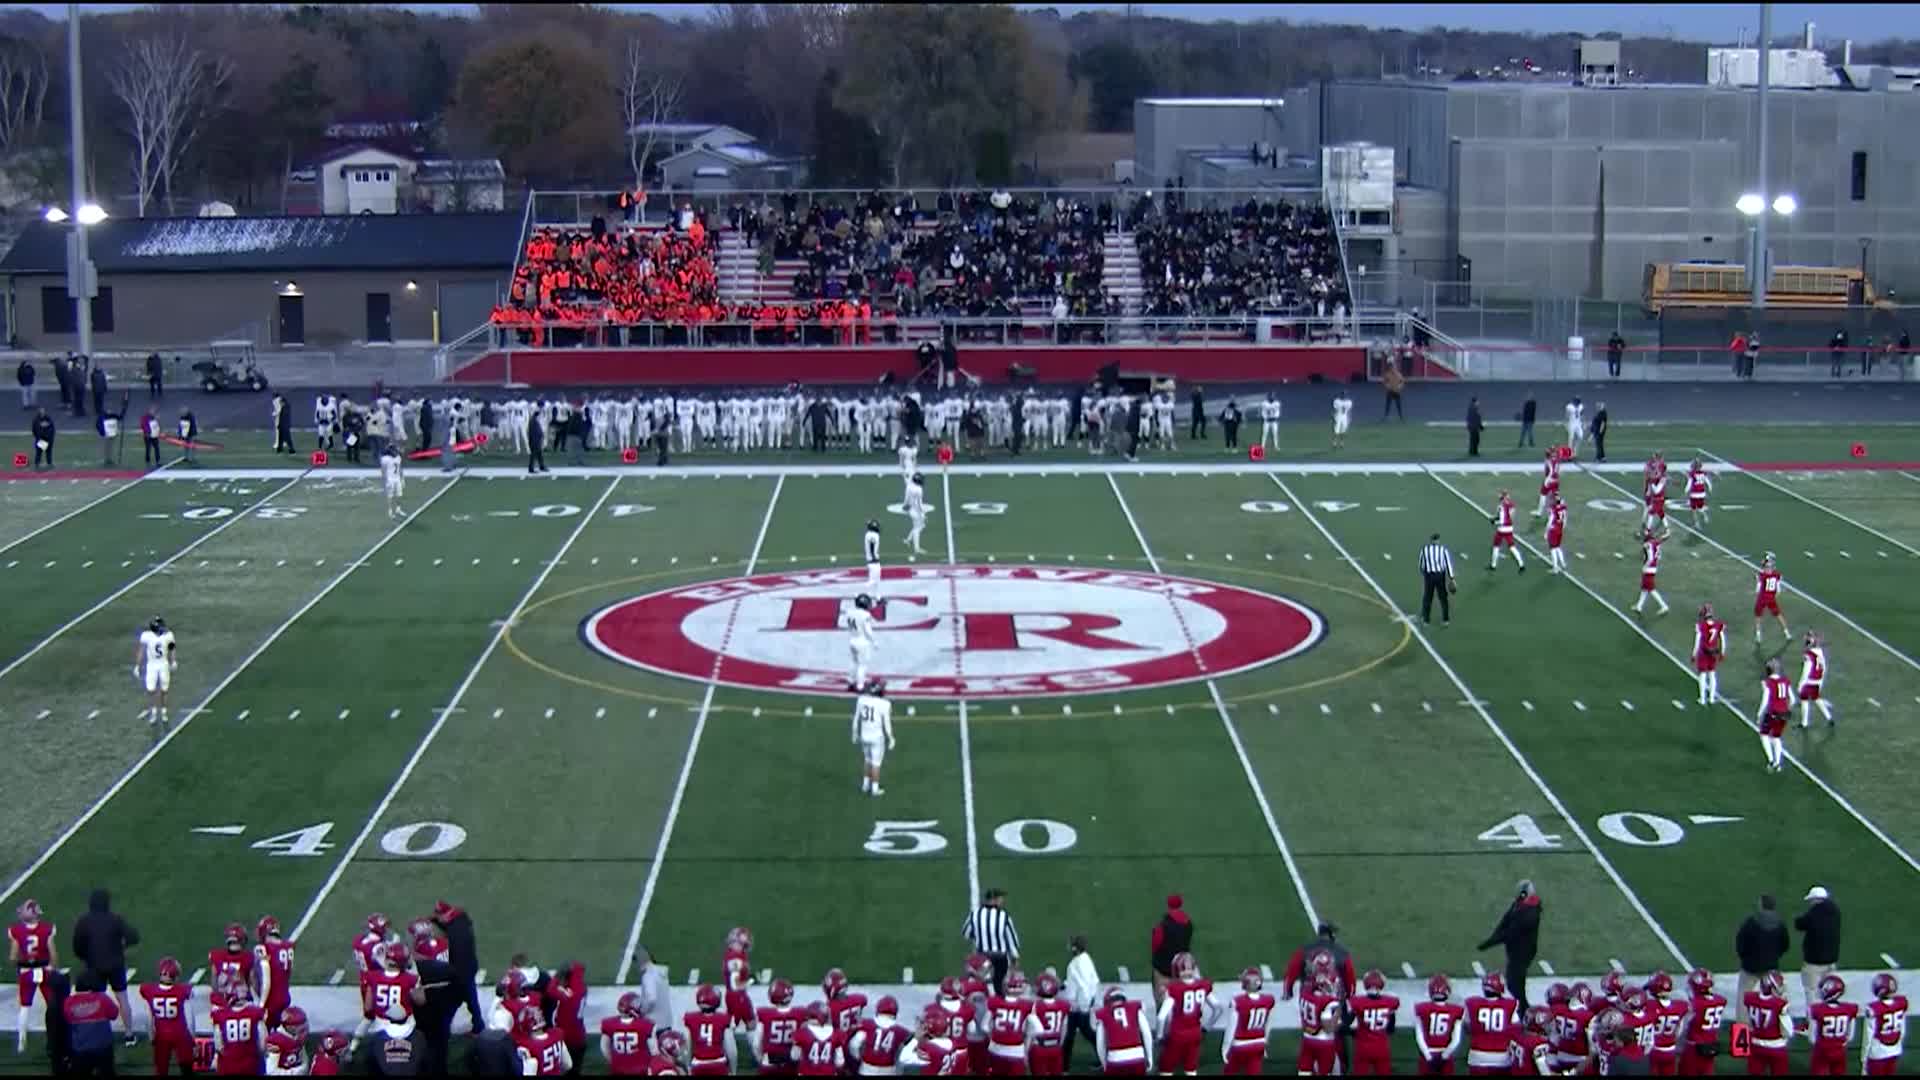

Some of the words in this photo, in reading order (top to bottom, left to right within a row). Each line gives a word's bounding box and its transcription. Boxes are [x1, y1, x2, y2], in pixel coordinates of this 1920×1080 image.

[861, 705, 875, 721] 31
[27, 935, 38, 954] 2
[376, 984, 401, 1007] 58
[1183, 989, 1205, 1014] 89
[152, 997, 178, 1018] 56
[1113, 1007, 1128, 1028] 9
[1249, 1008, 1267, 1029] 10
[1702, 1006, 1724, 1030] 55
[1750, 1008, 1772, 1029] 47
[226, 1019, 251, 1042] 88
[996, 1010, 1021, 1032] 24
[1044, 1011, 1063, 1033] 31
[1364, 1009, 1389, 1031] 45
[1429, 1012, 1449, 1035] 16
[1477, 1008, 1504, 1032] 90
[1822, 1015, 1847, 1037] 20
[612, 1032, 639, 1054] 62
[700, 1024, 713, 1047] 4
[770, 1020, 797, 1044] 52
[874, 1029, 895, 1051] 14
[809, 1041, 832, 1065] 44
